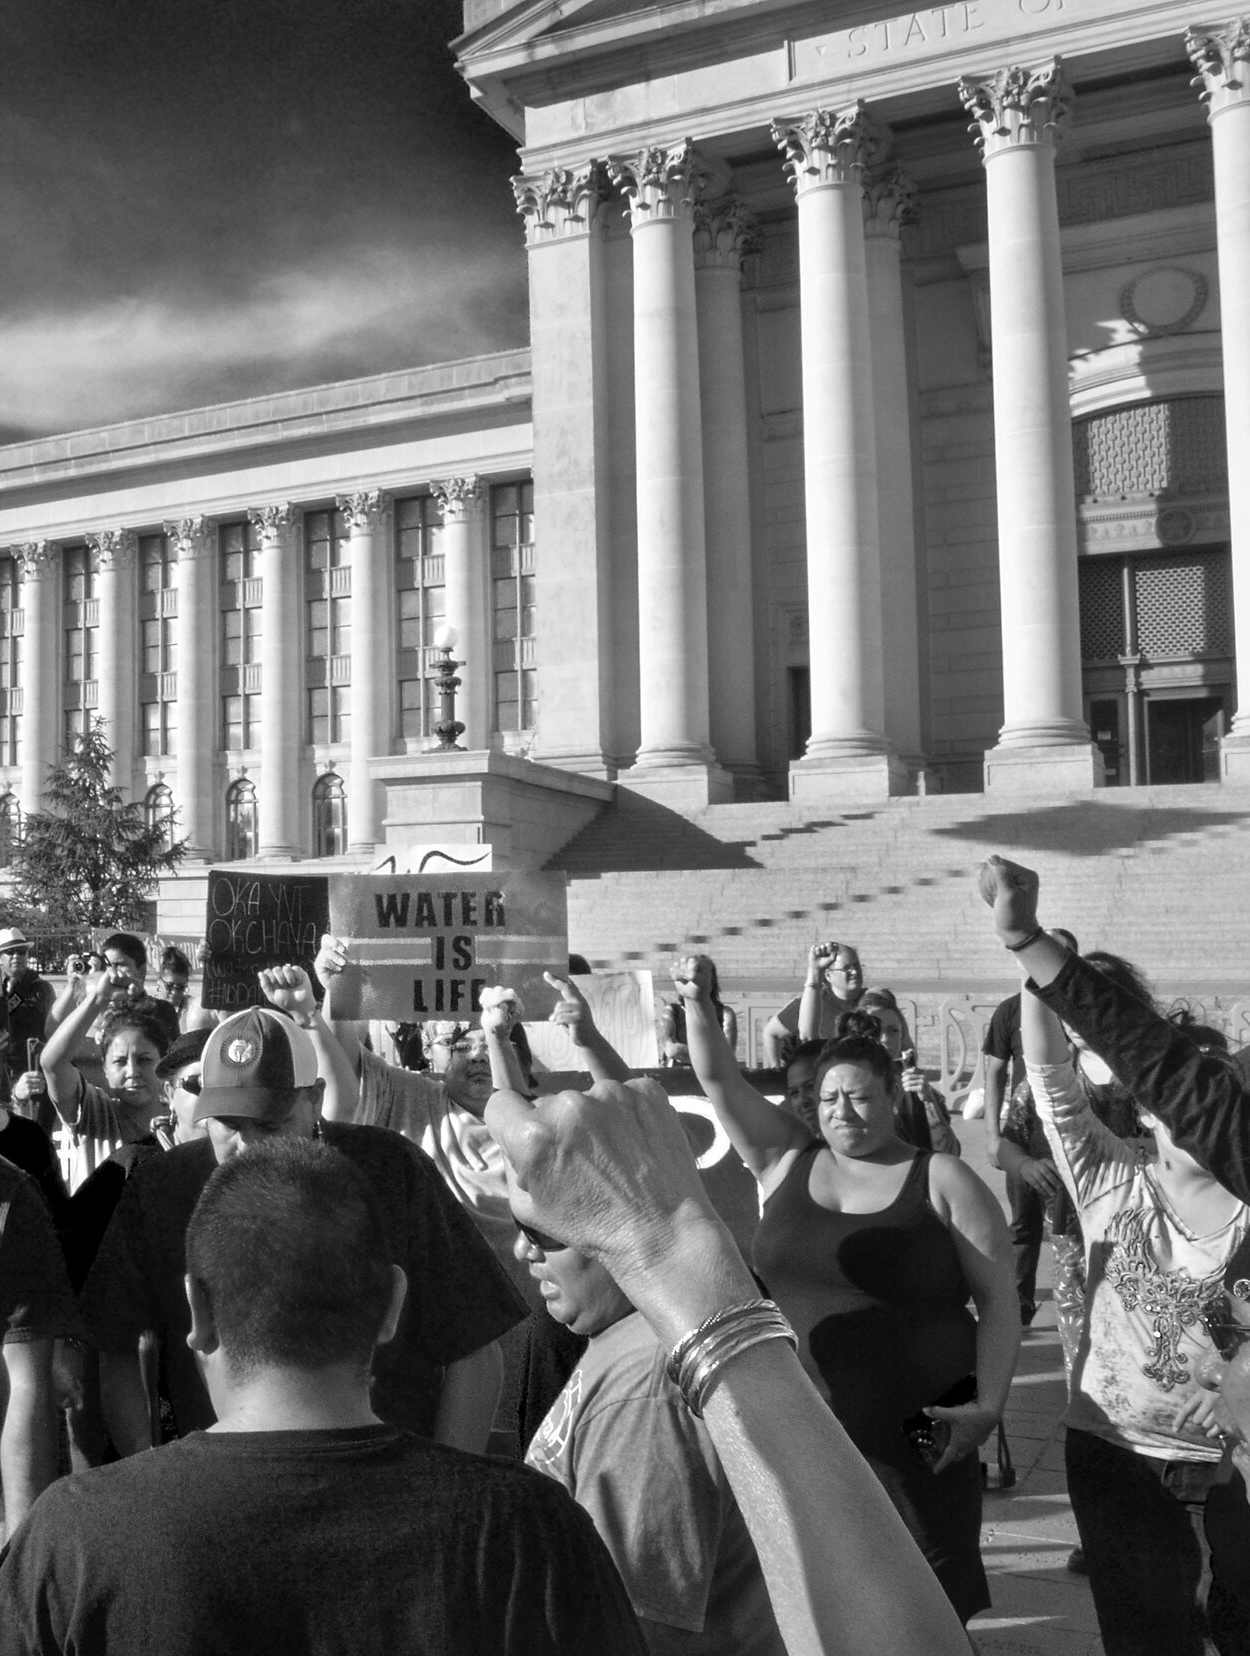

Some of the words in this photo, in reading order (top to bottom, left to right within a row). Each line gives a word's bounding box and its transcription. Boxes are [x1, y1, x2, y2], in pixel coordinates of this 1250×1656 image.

[848, 0, 985, 59] STATE
[211, 877, 261, 917] OKA
[375, 891, 507, 929] WATER
[209, 918, 317, 955] OKCHAYA
[435, 935, 473, 971] IS
